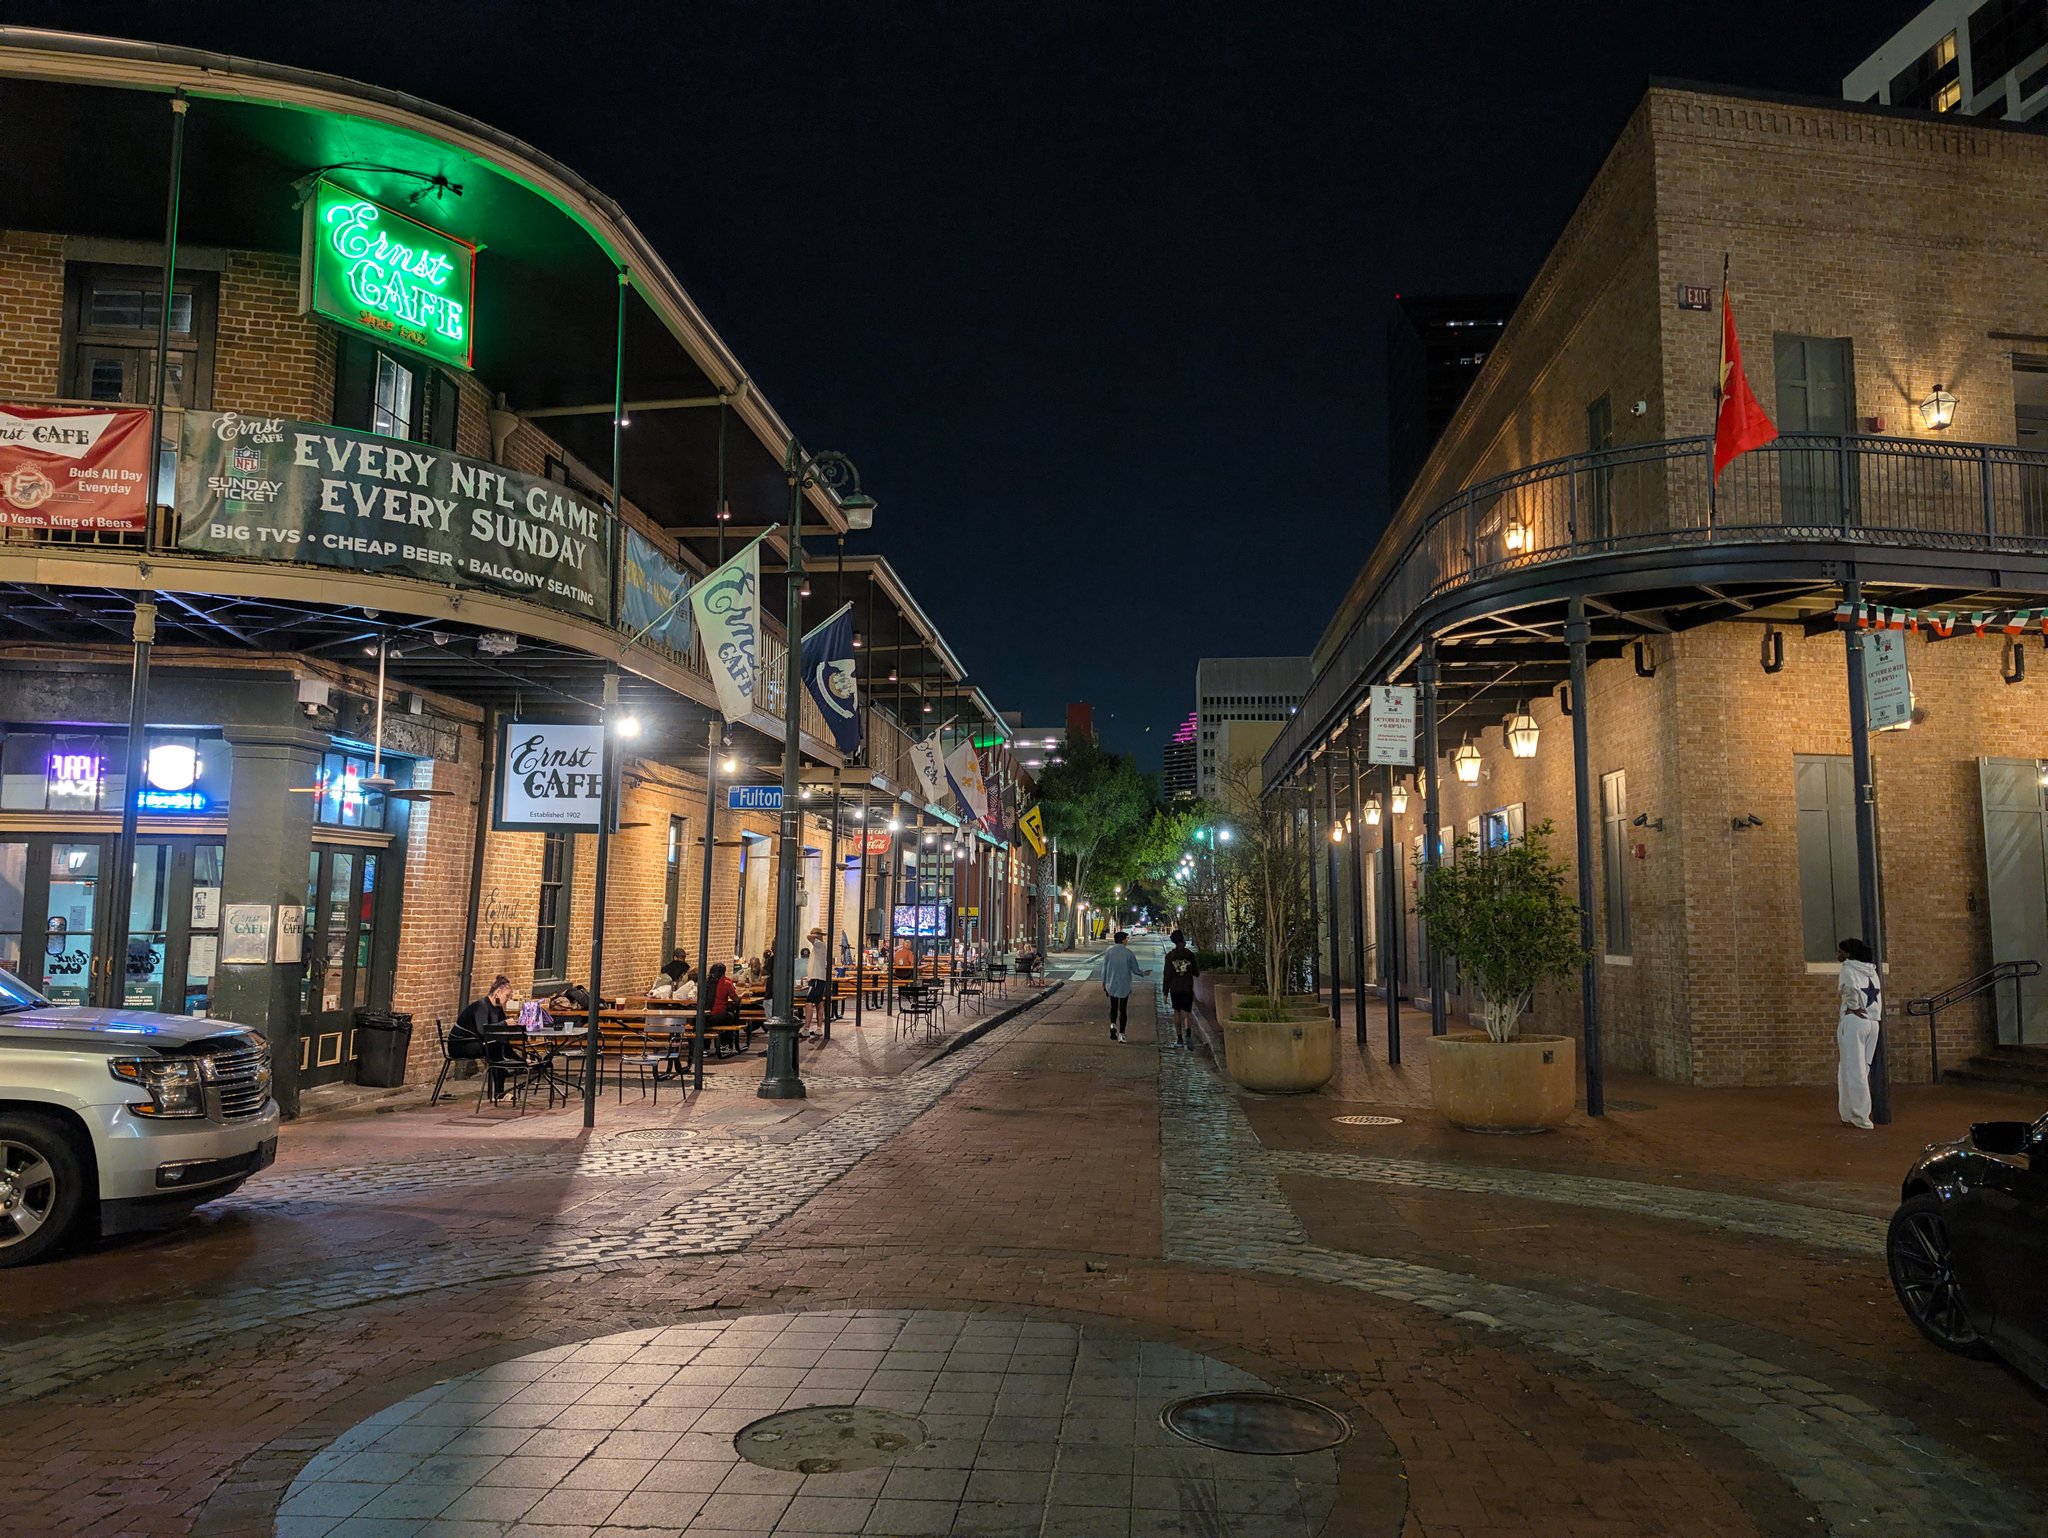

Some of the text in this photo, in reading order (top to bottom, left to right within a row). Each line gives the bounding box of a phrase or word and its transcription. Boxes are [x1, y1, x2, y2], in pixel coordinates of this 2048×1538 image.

[327, 202, 453, 285] Ernst
[347, 259, 463, 341] CAFE
[1688, 288, 1707, 304] EXIT
[212, 412, 285, 441] Ernst
[0, 426, 89, 445] nst CAFE
[252, 433, 284, 443] CAFE
[236, 457, 257, 470] NFL
[69, 468, 143, 482] Buds All Day
[79, 481, 131, 495] Everyday
[208, 477, 283, 492] SUNDAY
[294, 433, 599, 542] EVERY NFL GAME
[213, 487, 278, 502] TICKET
[11, 513, 47, 526] Years,
[50, 515, 79, 528] King
[81, 516, 94, 526] of
[97, 517, 132, 529] Beers
[320, 478, 587, 570] EVERY SUNDAY
[210, 523, 594, 606] BIG TVS CHEAP BEER BALCONY SEATING
[511, 735, 597, 775] Ernst
[523, 768, 602, 799] CAFE
[740, 788, 781, 807] Fulton
[234, 923, 267, 934] CAFE
[283, 923, 303, 934] CAFE
